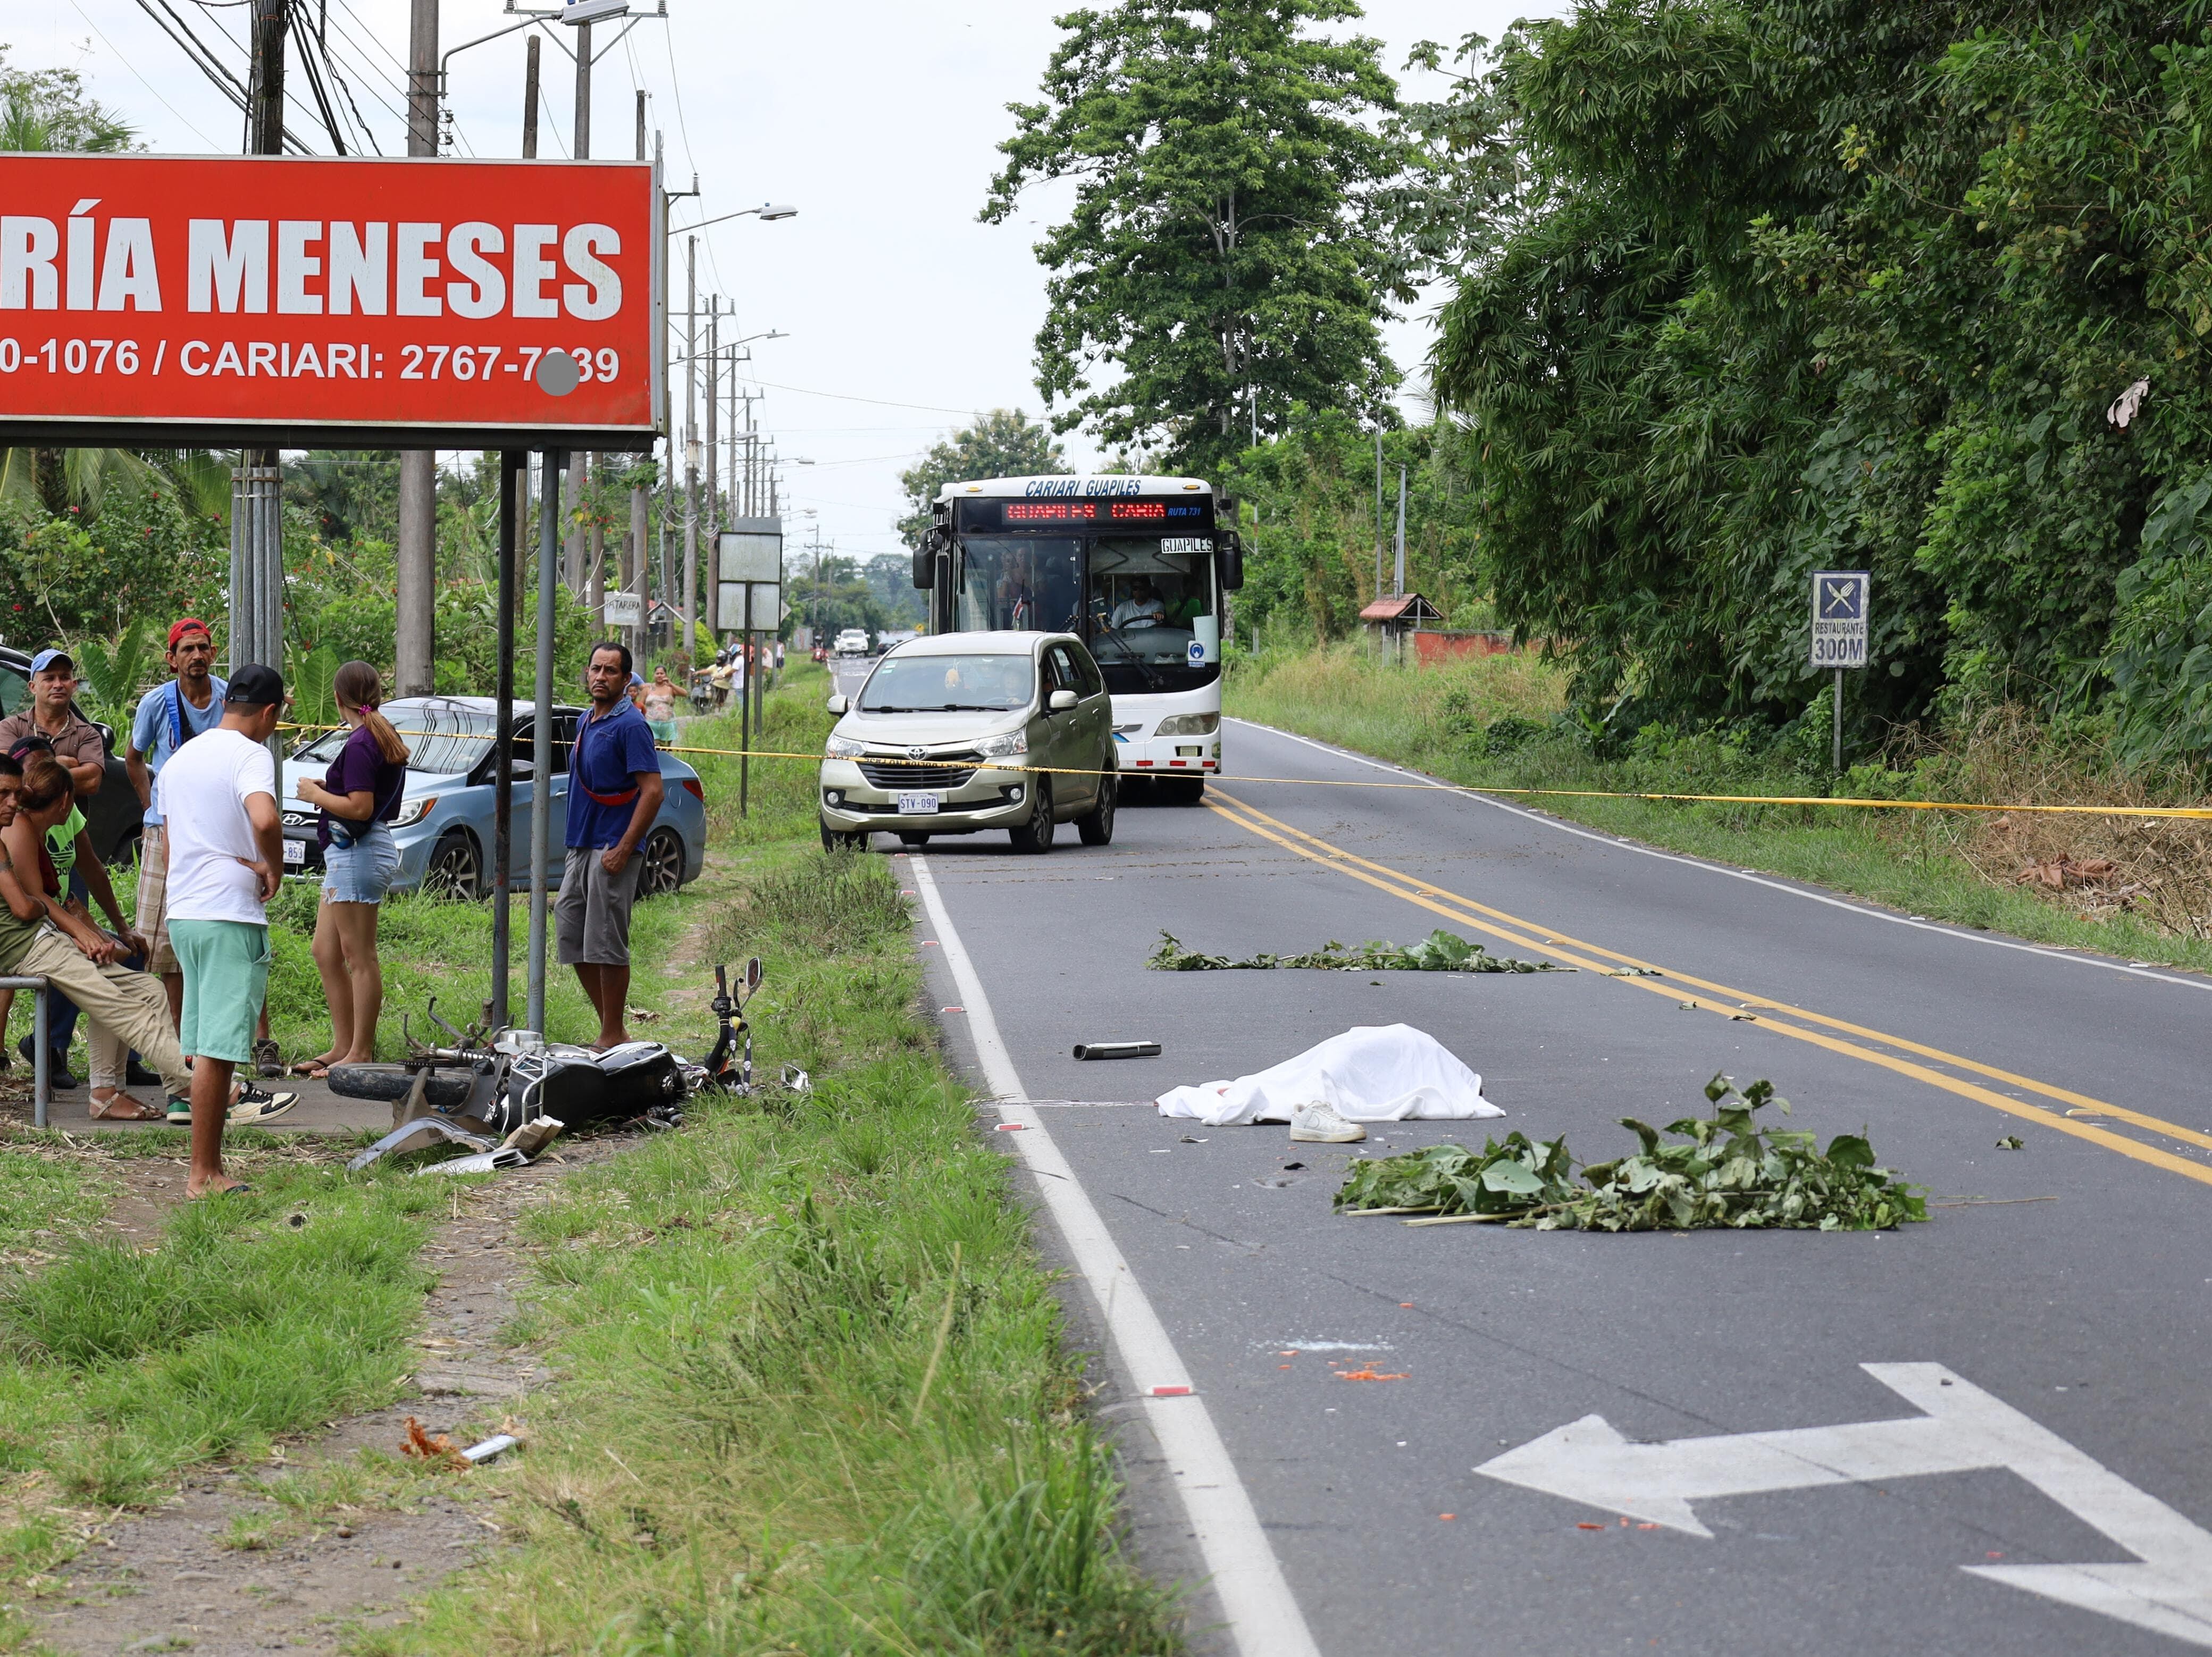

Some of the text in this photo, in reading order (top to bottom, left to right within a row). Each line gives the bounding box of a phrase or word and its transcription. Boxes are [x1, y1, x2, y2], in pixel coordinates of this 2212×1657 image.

[0, 198, 622, 321] RÍA MENESES
[152, 340, 166, 375] /
[180, 340, 383, 379] CARIARI:
[400, 345, 619, 382] 2767-739
[1025, 479, 1141, 497] CARIARI GUAPILES
[1168, 507, 1201, 516] RUTA 731
[1163, 537, 1212, 553] GUAPILES
[1815, 622, 1863, 635] RESTAURANTE
[1815, 638, 1863, 660] 300M
[900, 798, 936, 809] STV-090
